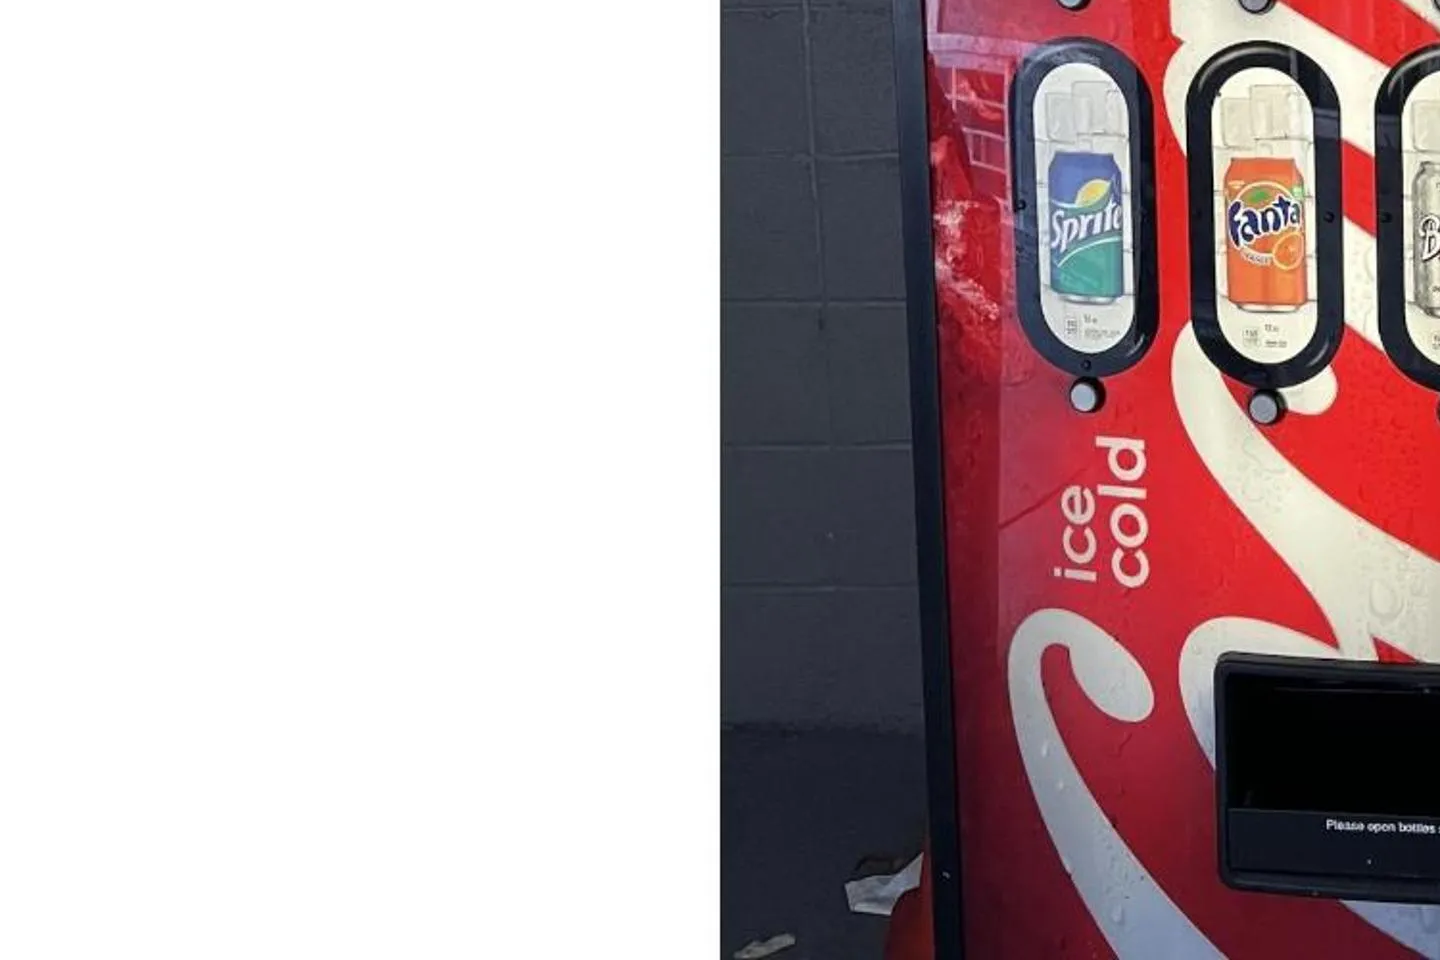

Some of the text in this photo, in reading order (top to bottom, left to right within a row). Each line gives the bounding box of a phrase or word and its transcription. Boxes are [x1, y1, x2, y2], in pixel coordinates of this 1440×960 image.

[1051, 197, 1123, 253] Sprite
[1053, 485, 1097, 583] ice
[1095, 436, 1150, 588] cold
[1326, 819, 1365, 831] Please
[1367, 822, 1397, 834] open
[1398, 822, 1436, 834] bottles
